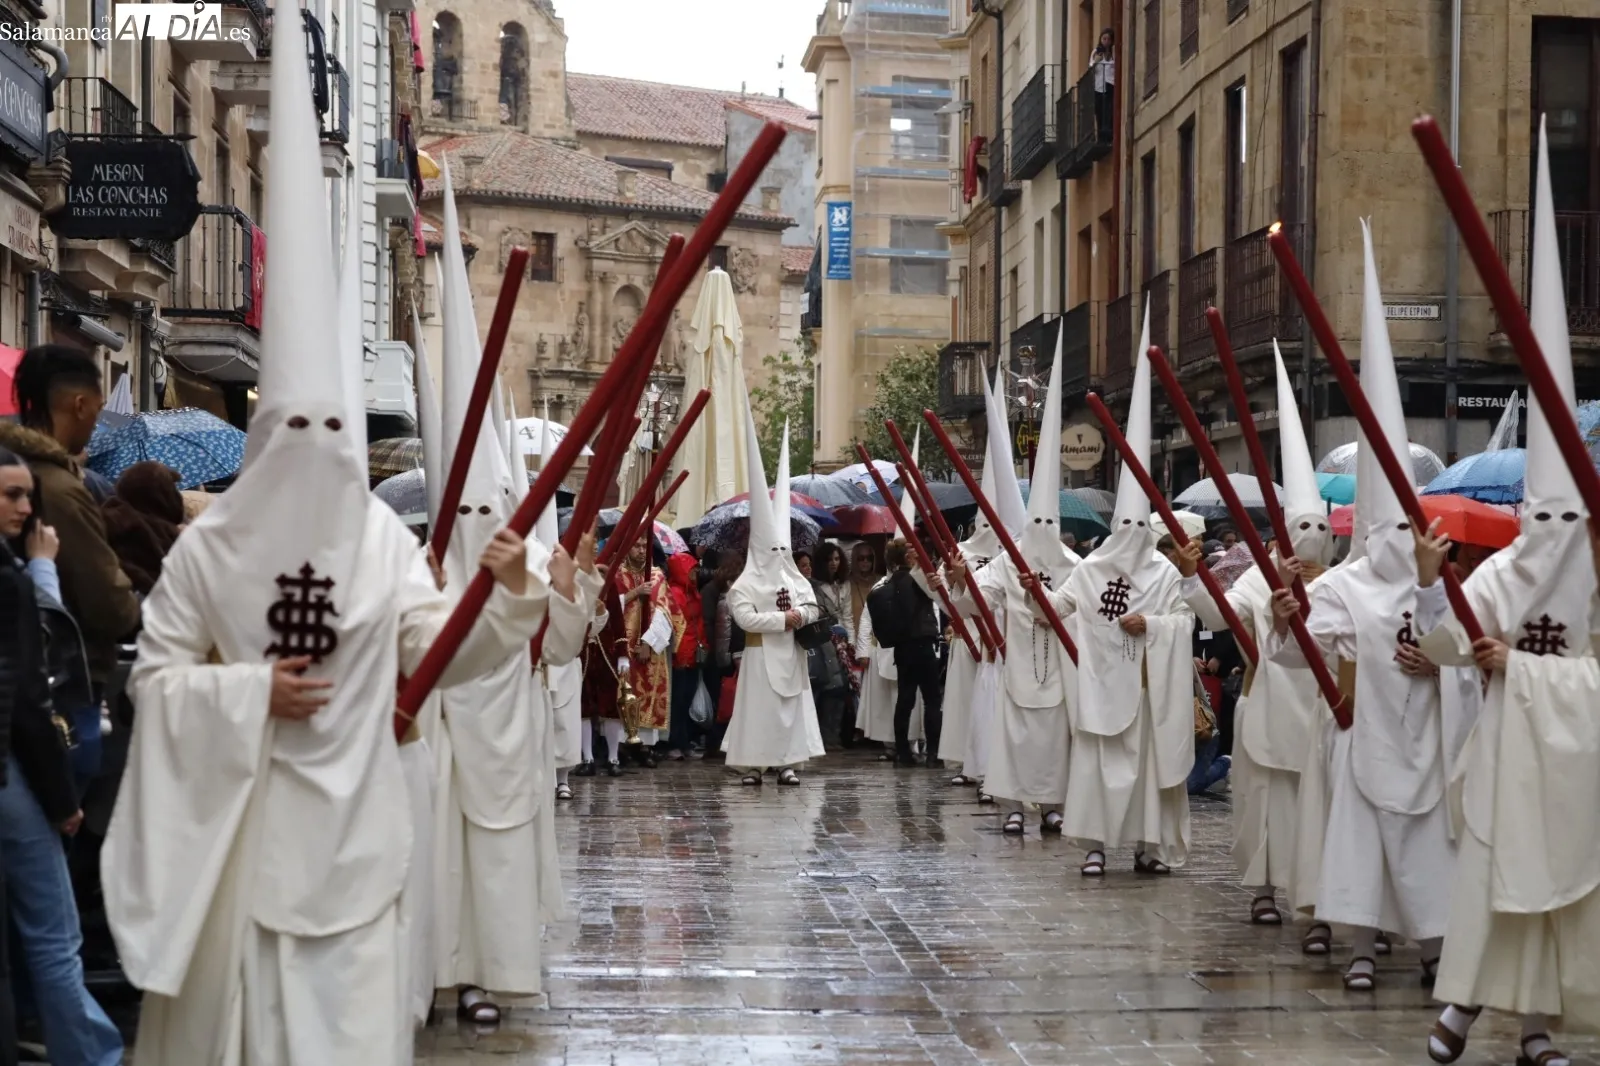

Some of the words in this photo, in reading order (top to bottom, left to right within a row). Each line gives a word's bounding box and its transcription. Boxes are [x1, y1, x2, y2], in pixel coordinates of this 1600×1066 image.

[91, 163, 144, 182] MESON
[68, 185, 94, 204] LAS
[97, 185, 168, 205] CONCHAS
[1387, 306, 1408, 316] FELIPE
[1409, 306, 1431, 316] ESPINO
